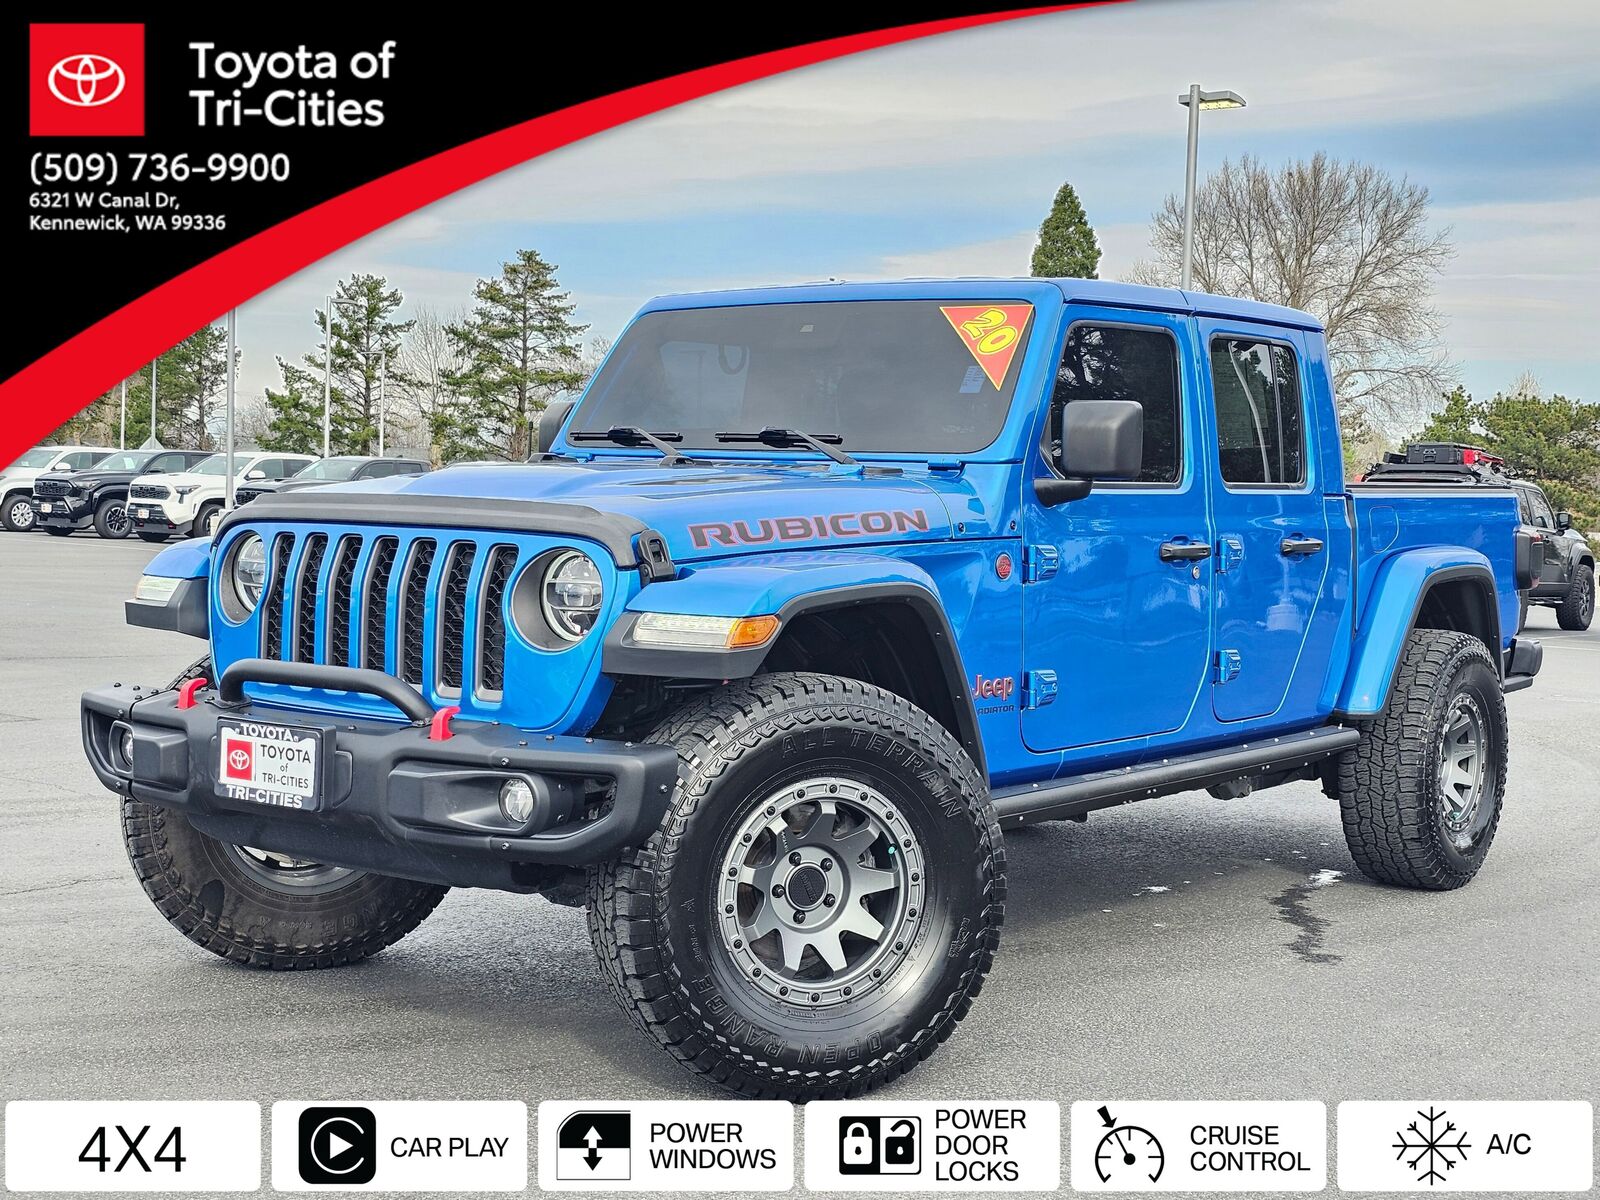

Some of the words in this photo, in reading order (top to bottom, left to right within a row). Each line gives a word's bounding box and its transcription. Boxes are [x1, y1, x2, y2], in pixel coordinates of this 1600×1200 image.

[960, 308, 1018, 355] 20
[687, 509, 929, 549] RUBICON
[973, 673, 1014, 701] Jeep
[977, 704, 1014, 715] ADIATOR
[240, 722, 293, 742] TOYOTA
[260, 744, 311, 764] TOYOTA
[262, 772, 309, 789] TRI-CITIES
[279, 763, 289, 773] of
[782, 726, 836, 759] ALL
[850, 727, 963, 818] TERRAIN
[226, 784, 303, 809] TRI-CITIES
[692, 973, 788, 1059] RANGE
[798, 1030, 882, 1064] OPEN
